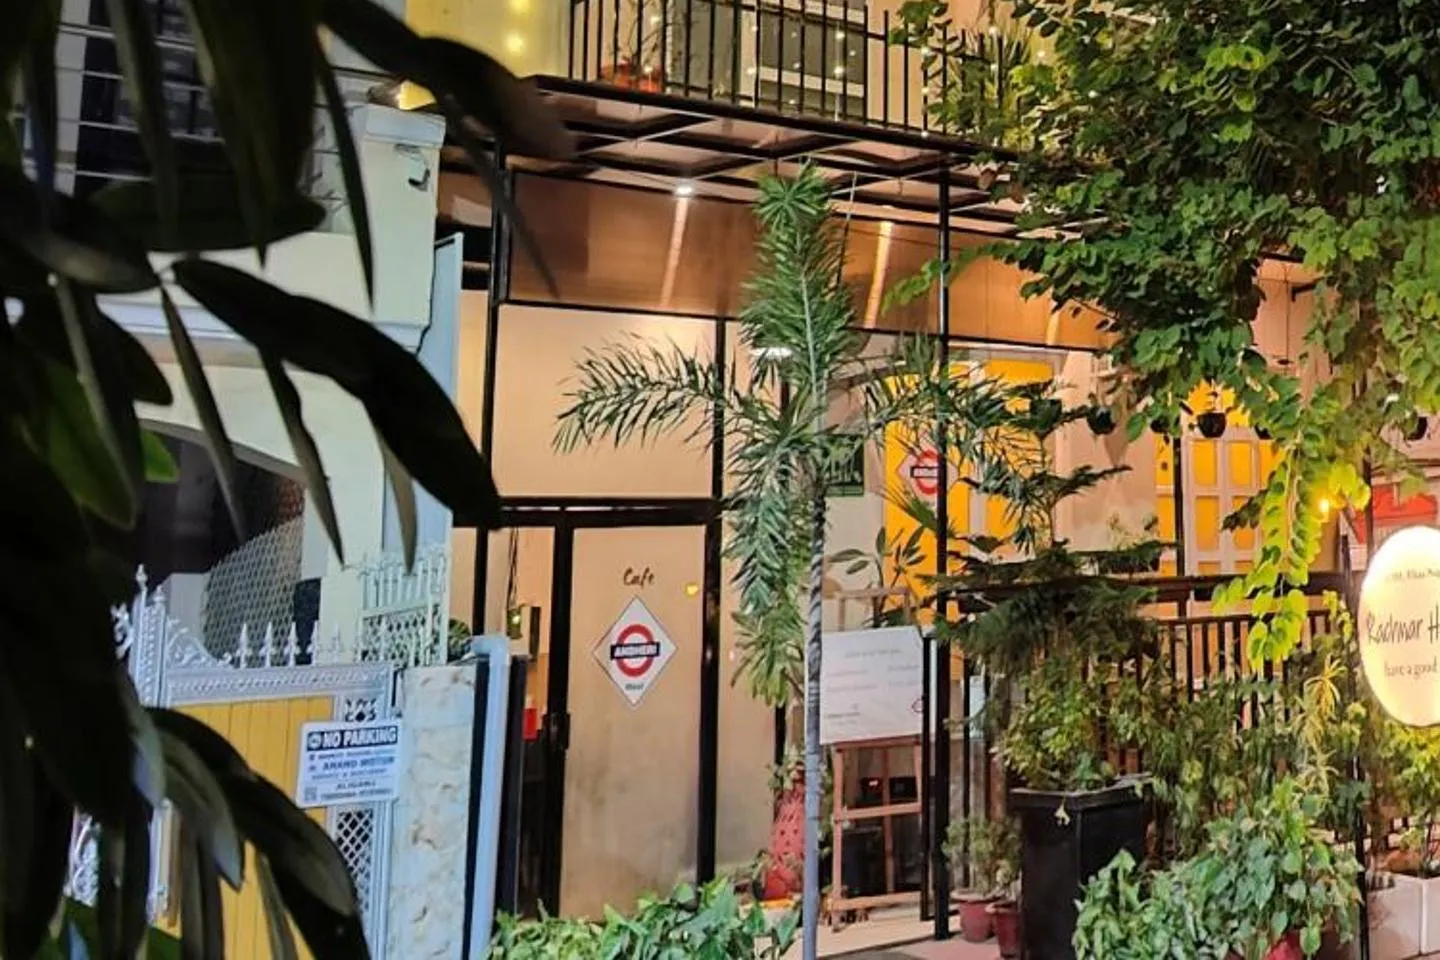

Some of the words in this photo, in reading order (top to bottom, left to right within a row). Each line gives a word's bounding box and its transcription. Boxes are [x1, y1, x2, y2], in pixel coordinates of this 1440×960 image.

[623, 566, 656, 588] Cafe
[321, 730, 341, 748] NO
[343, 726, 397, 746] PARKING
